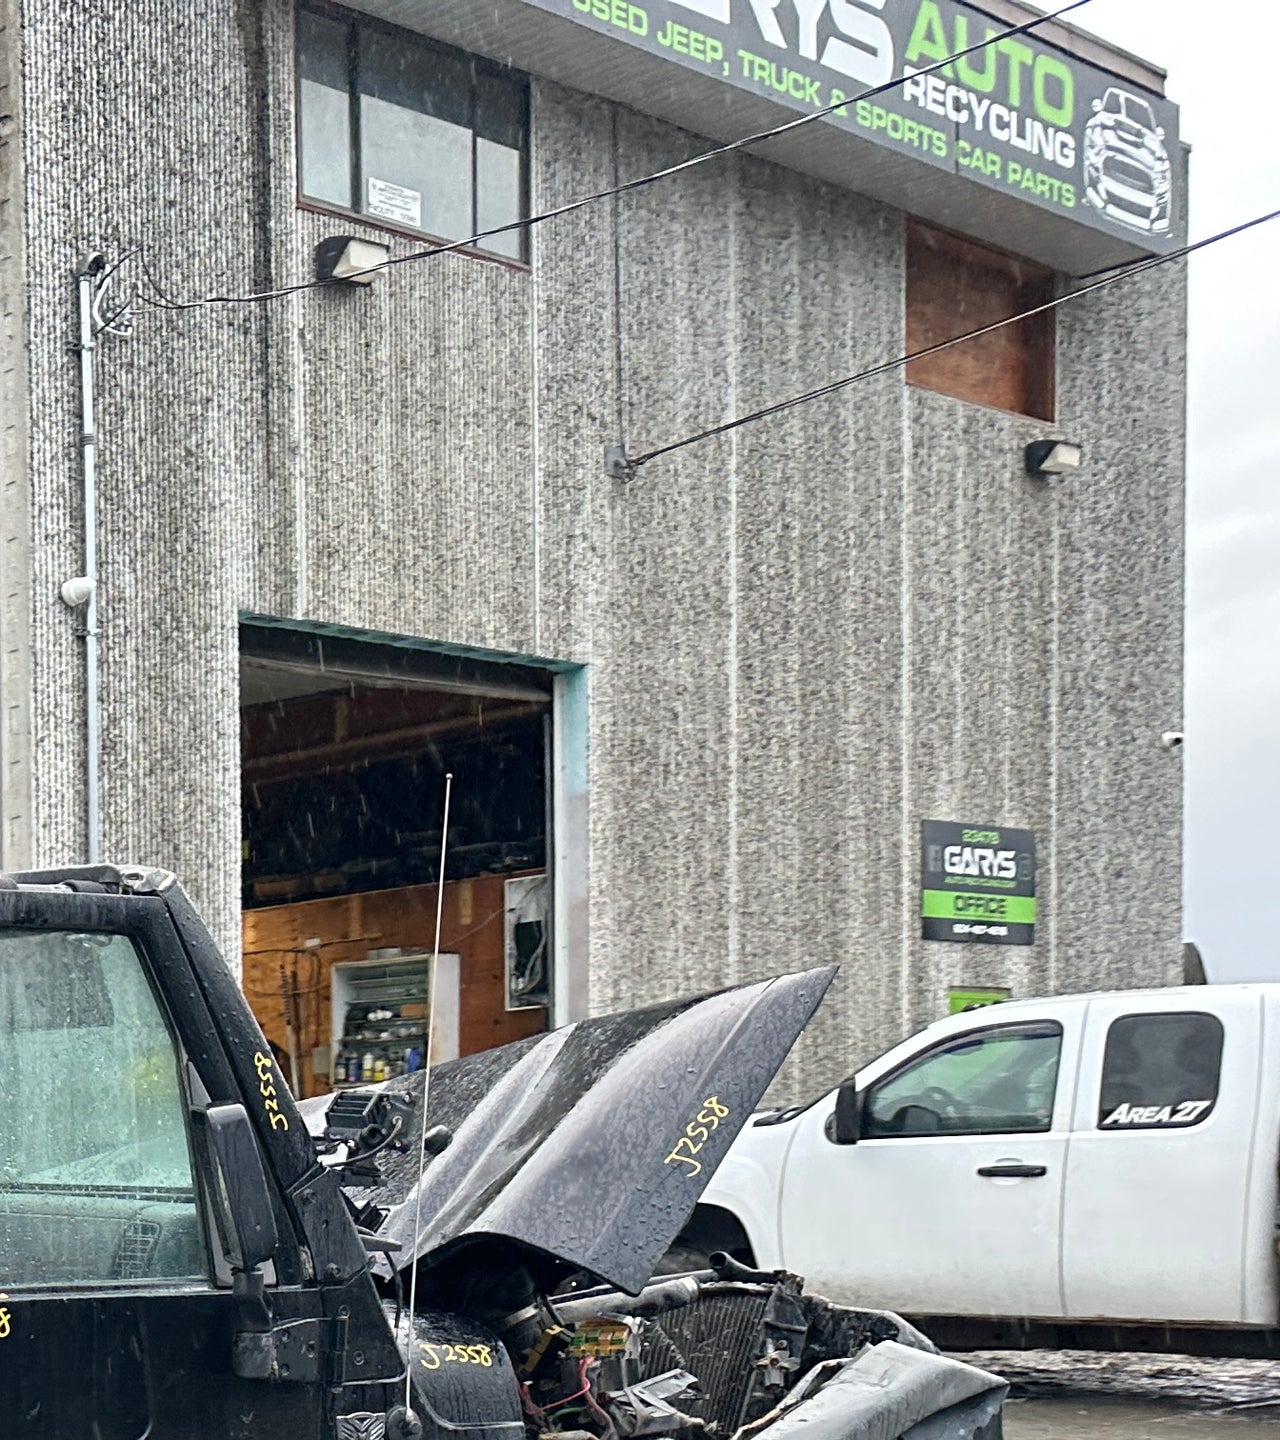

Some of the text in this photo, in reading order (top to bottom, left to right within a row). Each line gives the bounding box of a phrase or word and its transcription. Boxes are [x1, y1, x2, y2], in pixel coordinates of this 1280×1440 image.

[905, 0, 1074, 128] AUTO
[656, 20, 730, 77] JEEP,
[737, 50, 822, 107] TRUCK
[856, 100, 948, 159] SPORTS
[954, 141, 1002, 180] CAR
[1007, 162, 1077, 209] PARTS
[902, 65, 1077, 169] RECYCLING
[943, 845, 1018, 879] GARYS
[952, 894, 1008, 915] OFFICE
[254, 1051, 289, 1132] J2558
[663, 1095, 730, 1174] J2558
[419, 1343, 493, 1370] J2558
